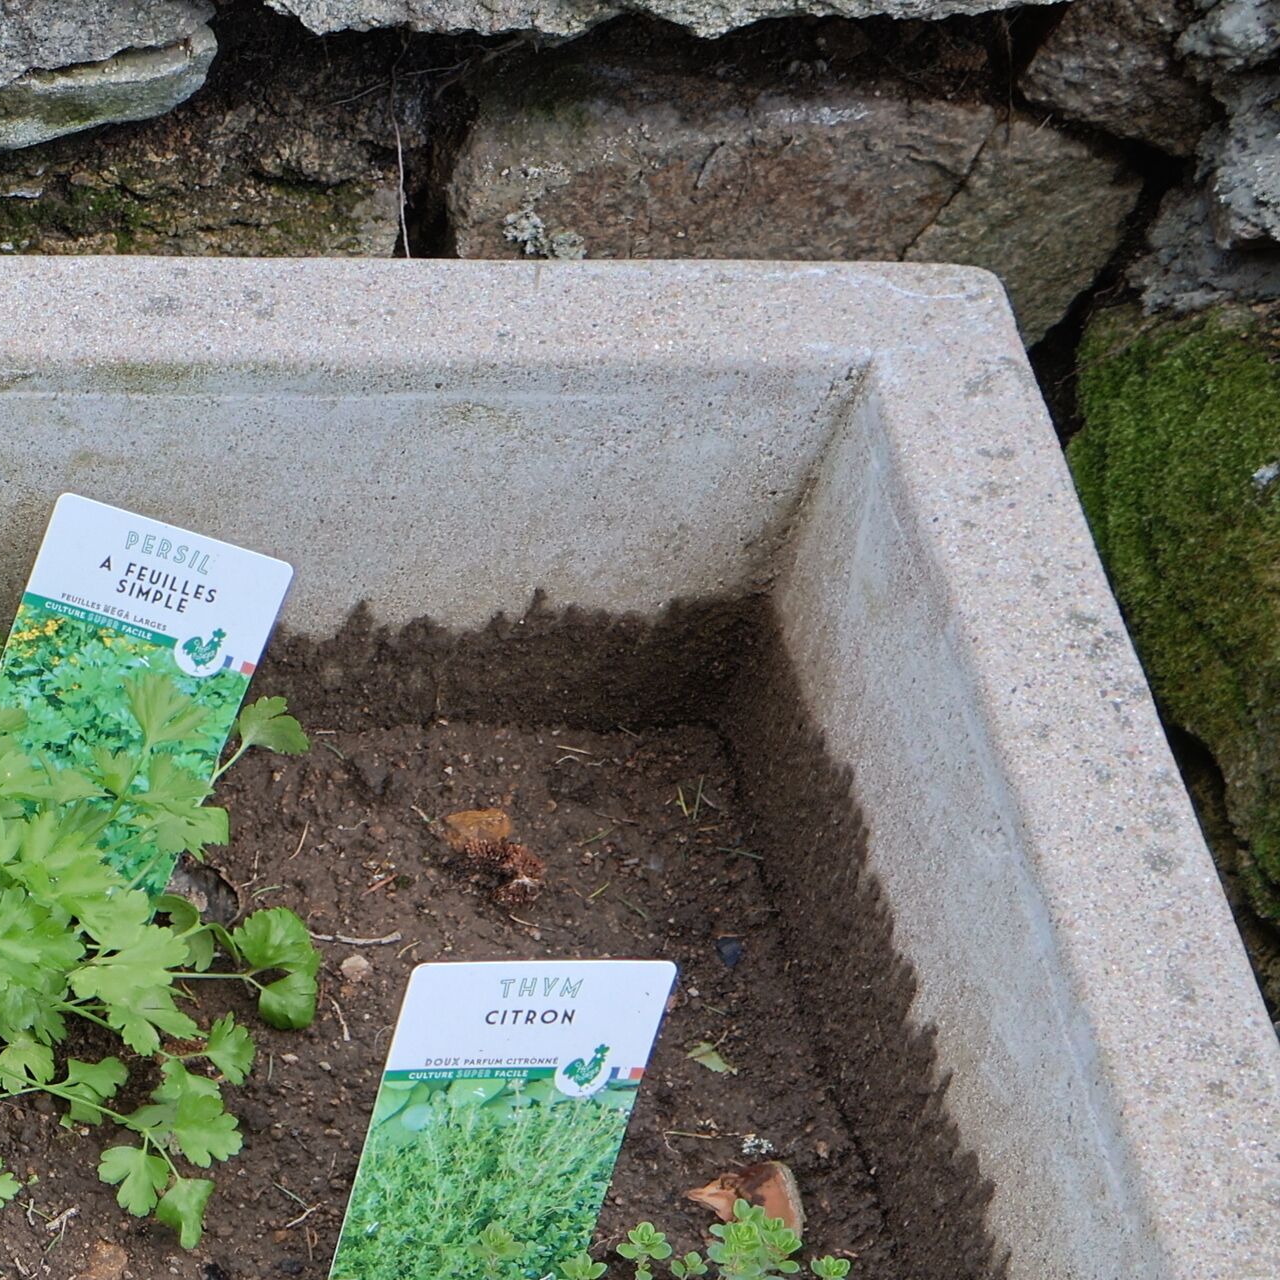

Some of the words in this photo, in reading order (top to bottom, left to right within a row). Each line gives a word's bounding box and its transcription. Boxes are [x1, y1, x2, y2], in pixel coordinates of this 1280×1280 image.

[125, 530, 209, 575] PERSIL
[99, 555, 112, 571] A
[124, 562, 217, 603] FEUILLES
[116, 579, 188, 614] SIMPLE
[45, 601, 85, 619] CULTURE
[87, 613, 120, 630] SUPER
[121, 624, 153, 641] FACILE
[61, 592, 100, 610] FEUILLES
[133, 615, 167, 632] LARGES
[500, 977, 584, 999] THYM
[485, 1009, 576, 1026] CITRON
[408, 1071, 454, 1080] CULTURE
[455, 1069, 491, 1079] SUPER
[494, 1069, 529, 1078] FACILE
[425, 1057, 461, 1067] DOUX
[463, 1058, 503, 1066] PARFUM
